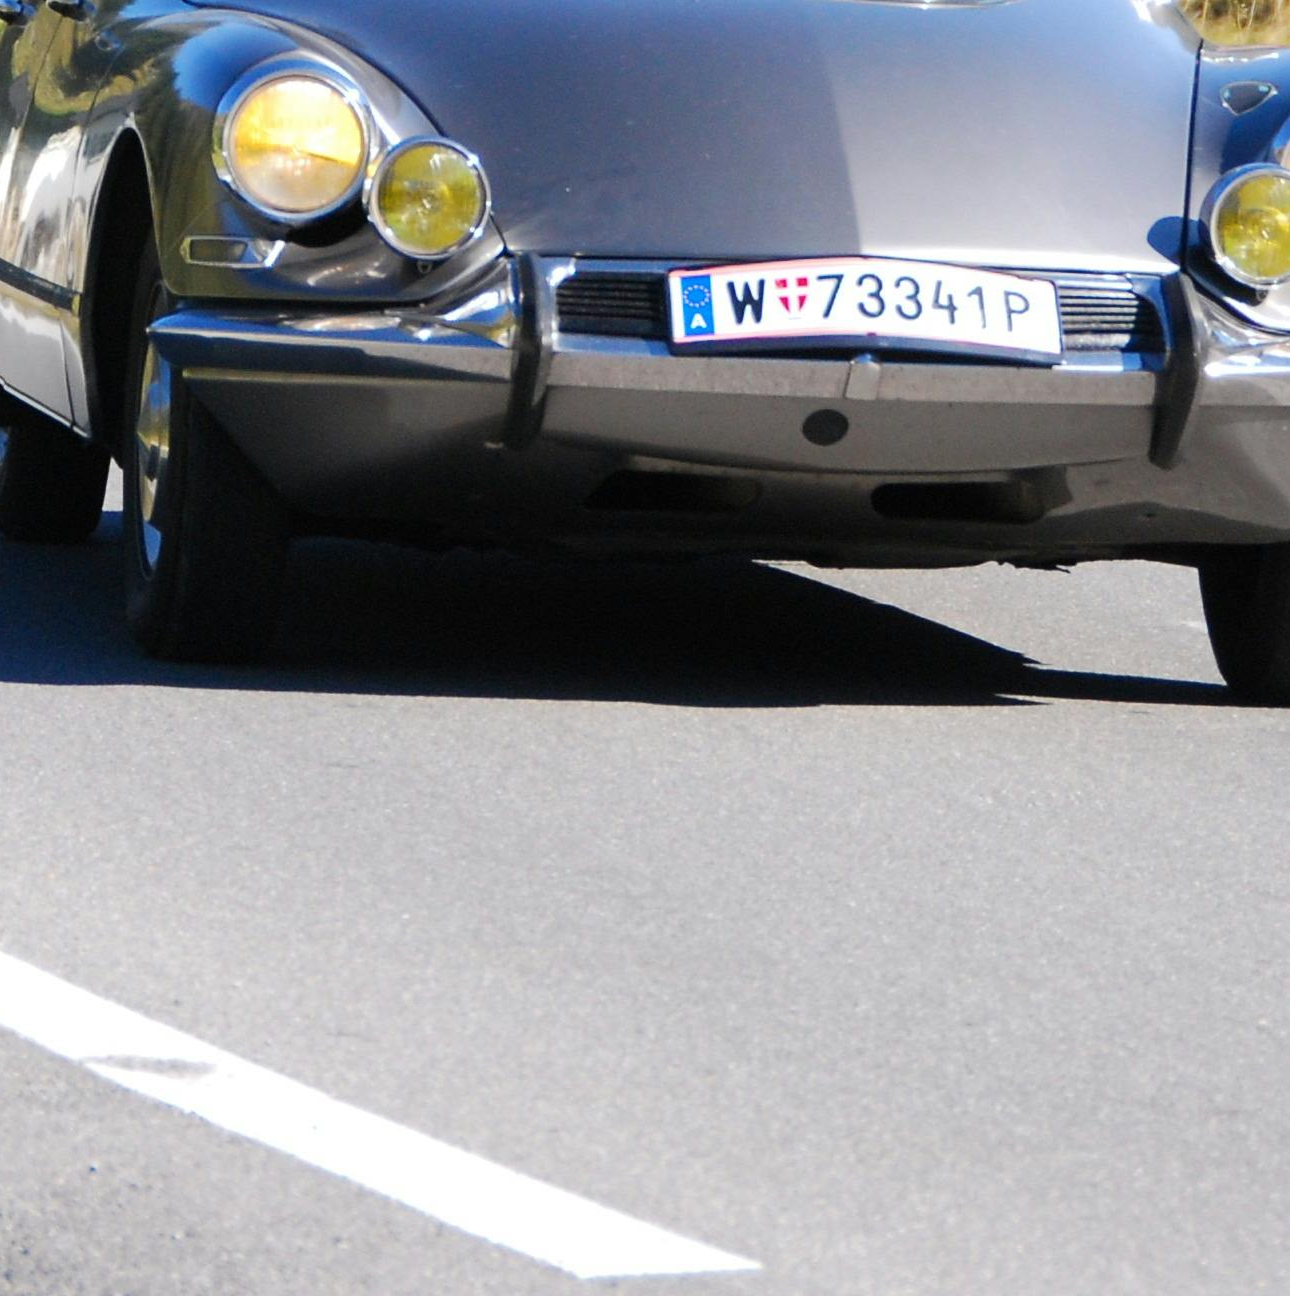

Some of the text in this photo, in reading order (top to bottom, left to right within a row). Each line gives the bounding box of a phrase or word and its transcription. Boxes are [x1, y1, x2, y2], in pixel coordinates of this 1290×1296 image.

[690, 312, 708, 329] A
[726, 273, 1030, 332] W 73341P
